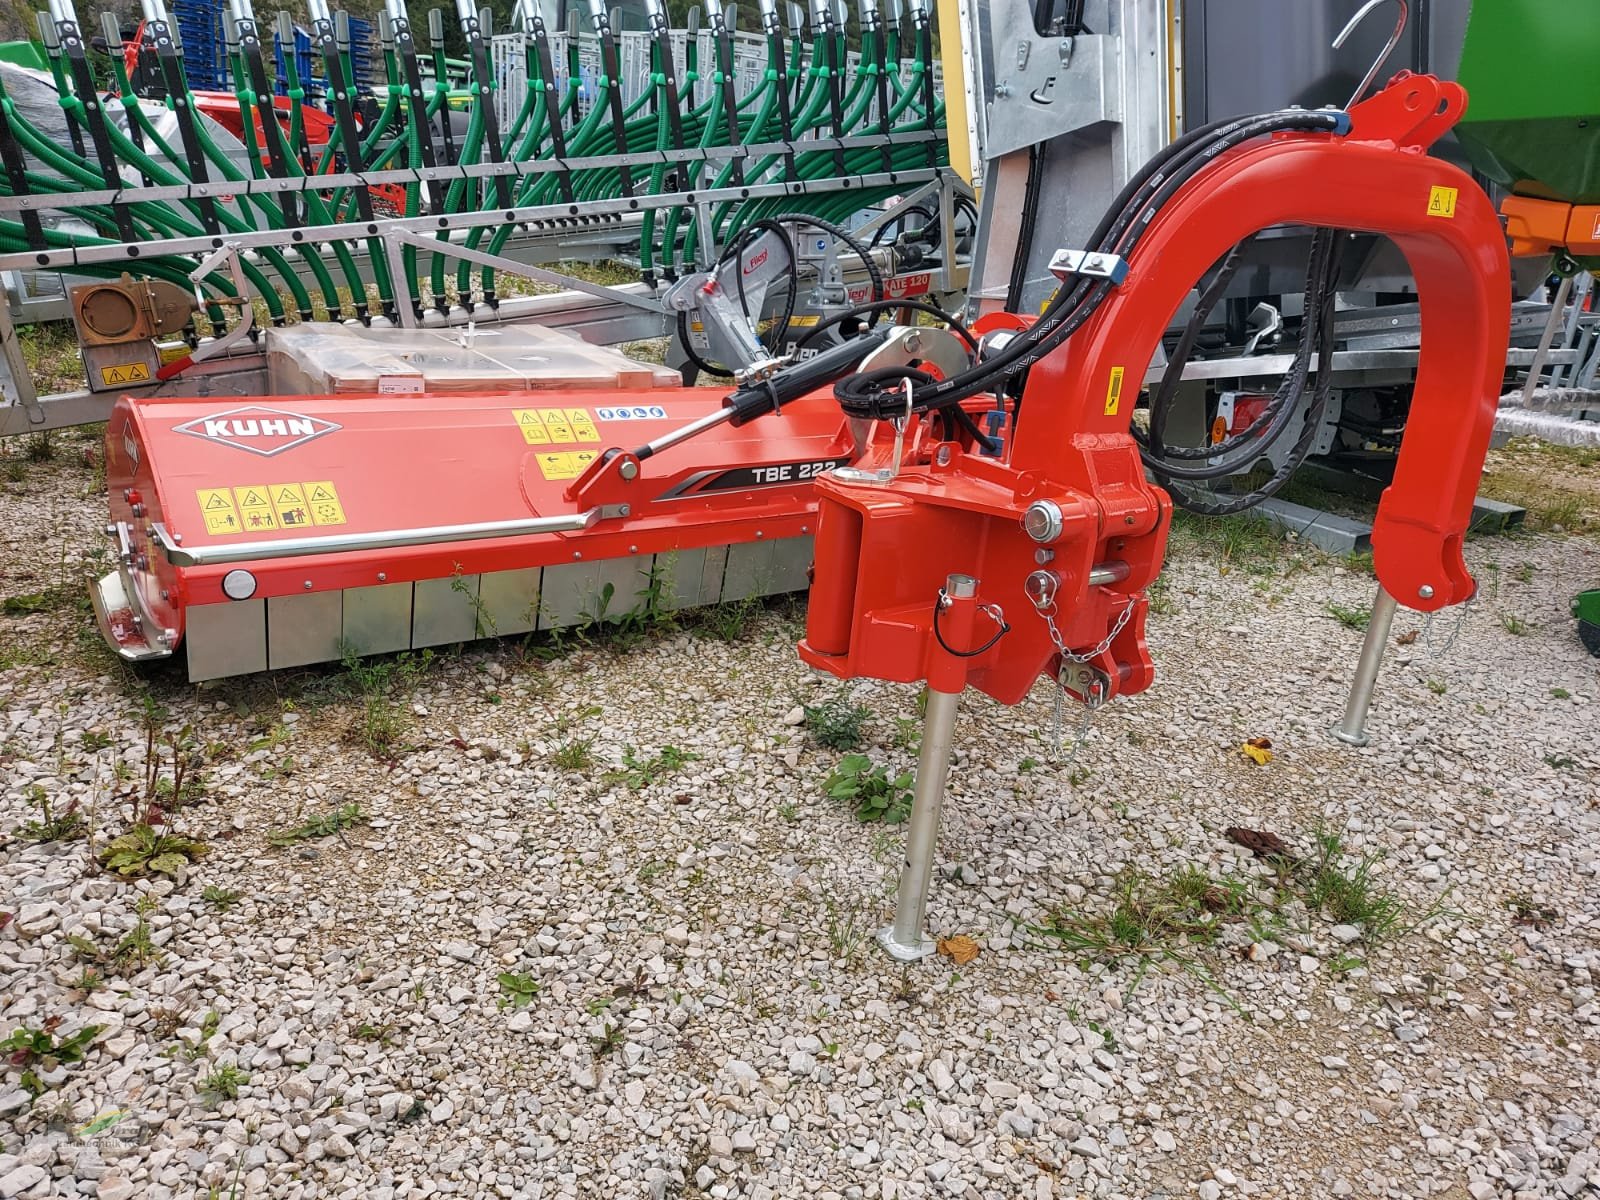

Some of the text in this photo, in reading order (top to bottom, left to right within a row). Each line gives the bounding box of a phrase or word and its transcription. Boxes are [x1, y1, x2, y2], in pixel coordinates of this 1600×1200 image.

[882, 274, 929, 292] KATE 120
[203, 418, 316, 437] KUHN
[752, 461, 836, 483] TBE 222
